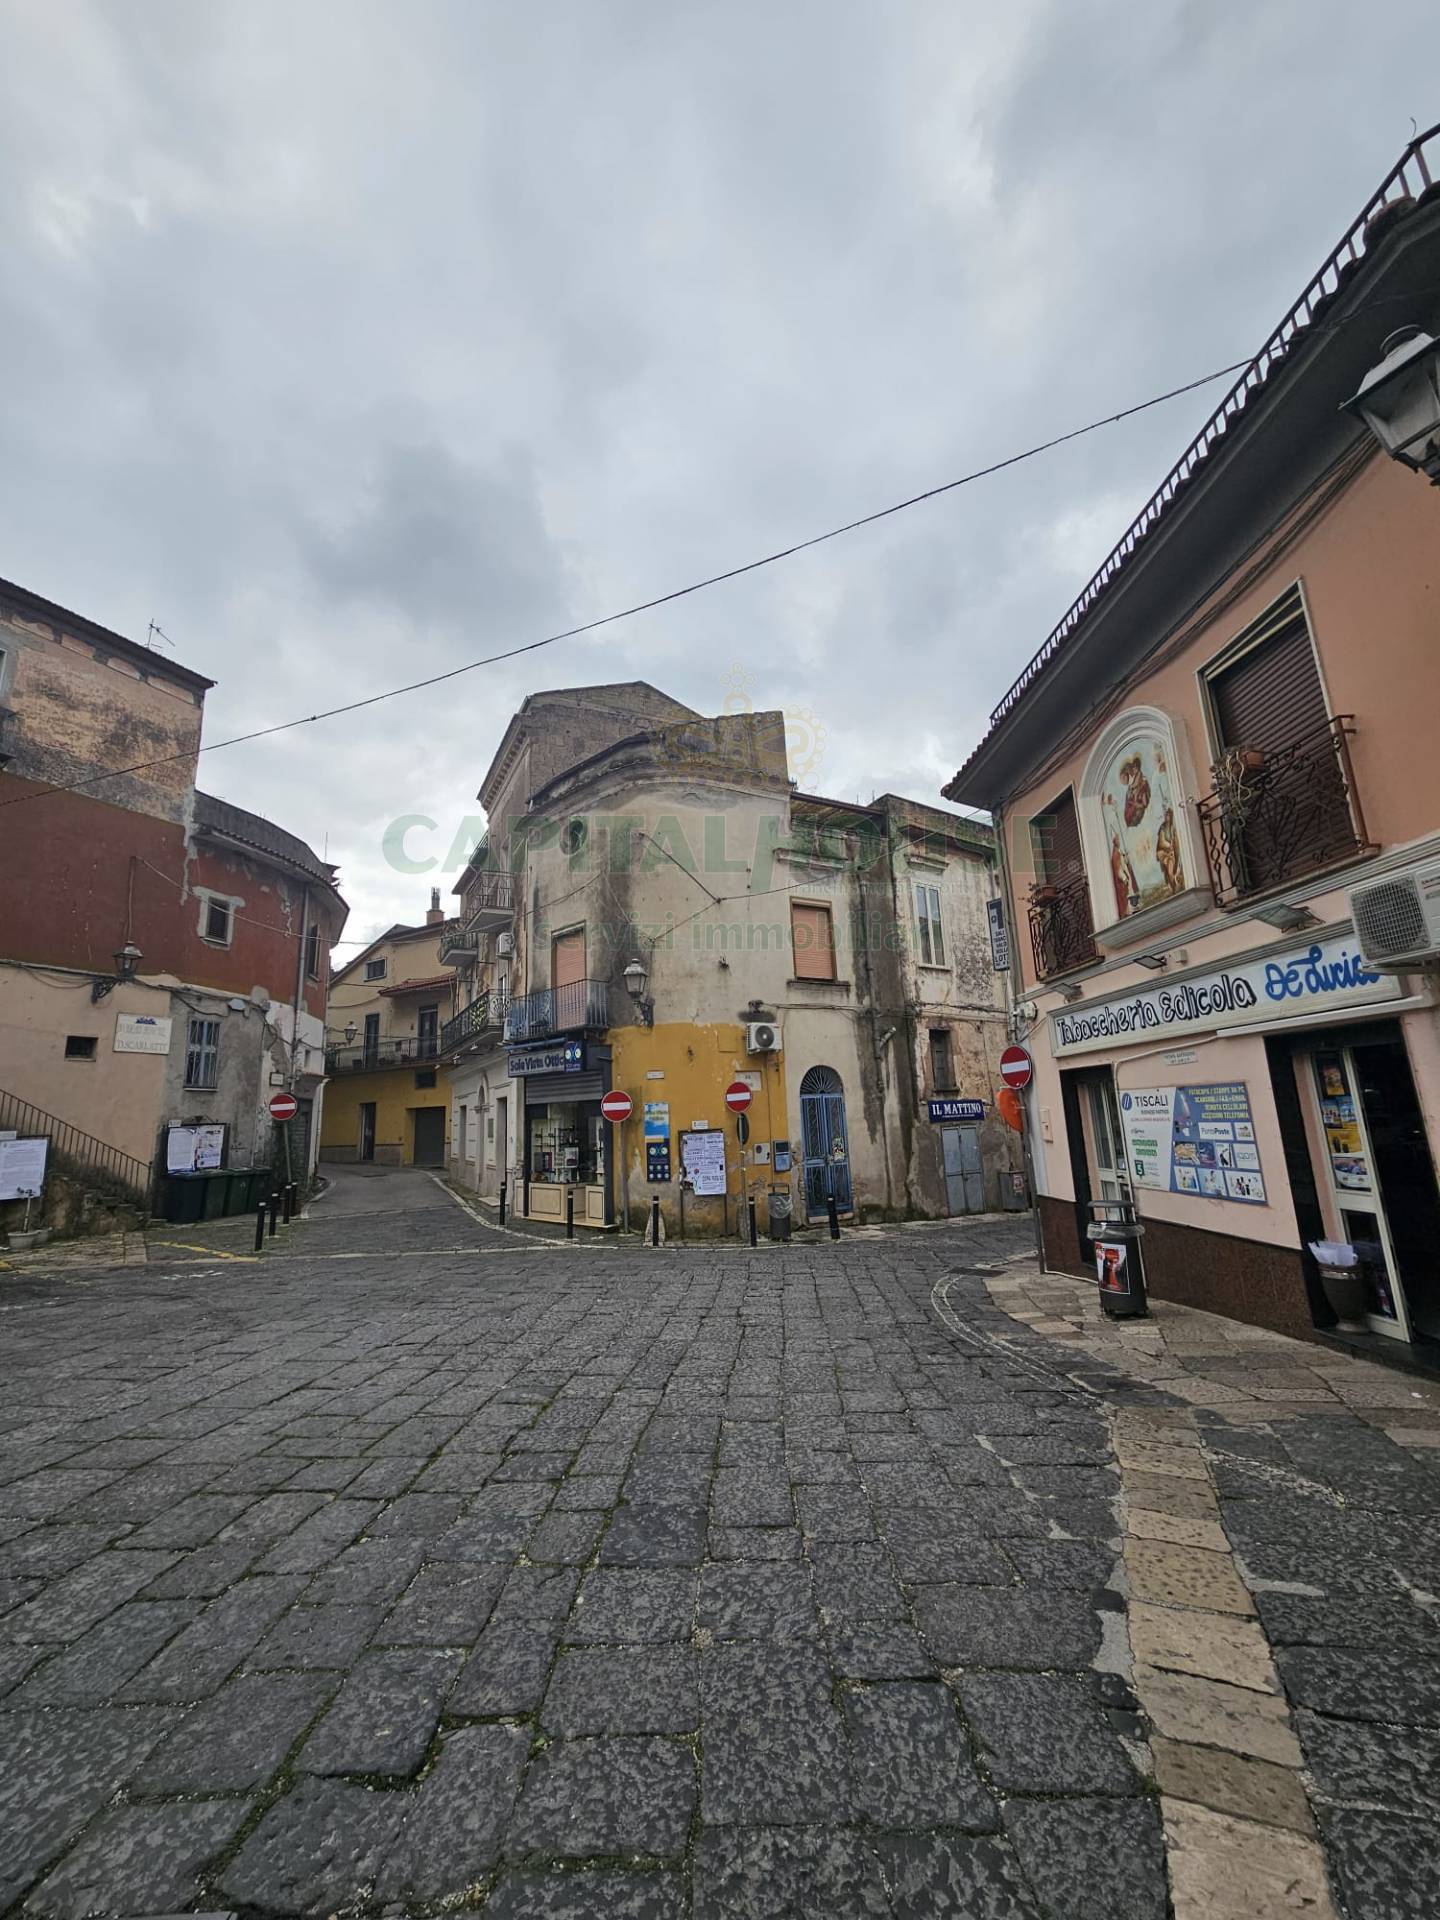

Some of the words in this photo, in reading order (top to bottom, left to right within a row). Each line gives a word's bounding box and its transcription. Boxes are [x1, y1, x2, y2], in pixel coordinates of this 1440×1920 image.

[1057, 1000, 1160, 1046] Tabaccheria
[1159, 974, 1257, 1022] Edicola
[1264, 963, 1303, 1000] De
[1135, 1094, 1169, 1107] TISCALI
[932, 1104, 942, 1115] IL
[944, 1103, 981, 1115] MATTINO
